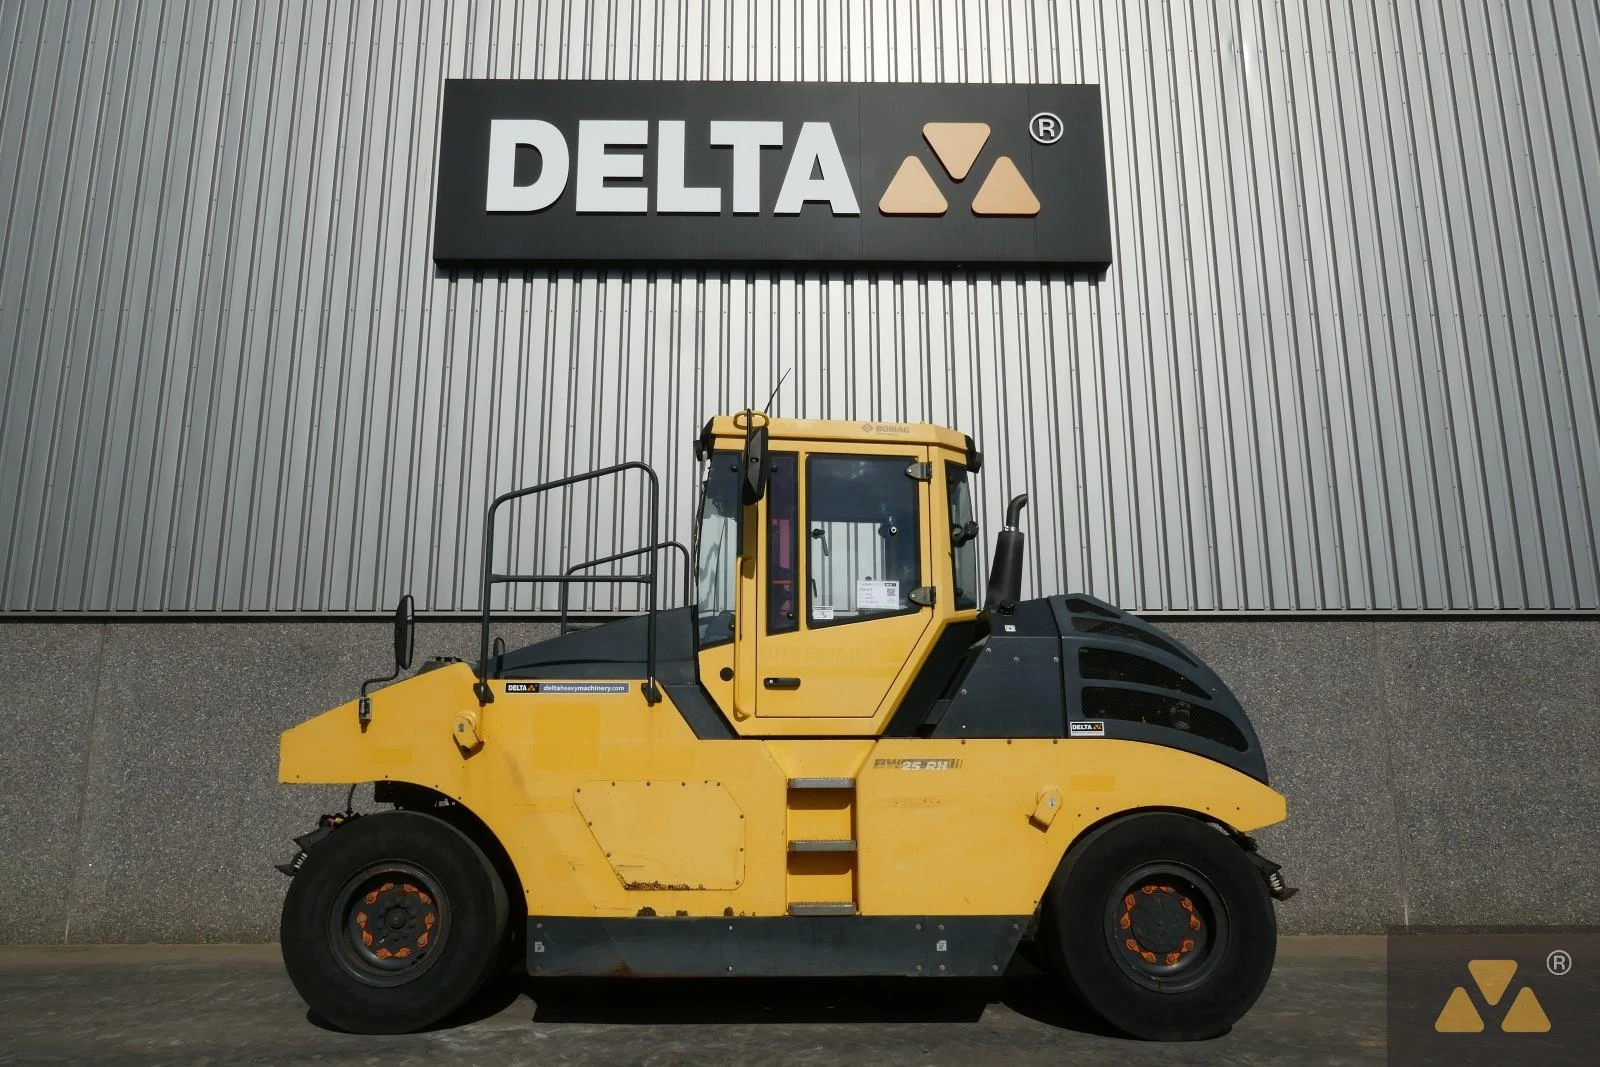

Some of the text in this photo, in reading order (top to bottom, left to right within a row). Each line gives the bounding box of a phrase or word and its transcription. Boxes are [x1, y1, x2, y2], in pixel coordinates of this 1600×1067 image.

[485, 118, 861, 216] DELTA
[876, 424, 910, 434] BOMAG
[507, 682, 625, 693] DELTA deltaheavymachinery.com
[1072, 723, 1093, 731] DELTA
[901, 760, 922, 771] 25
[925, 760, 949, 771] RH
